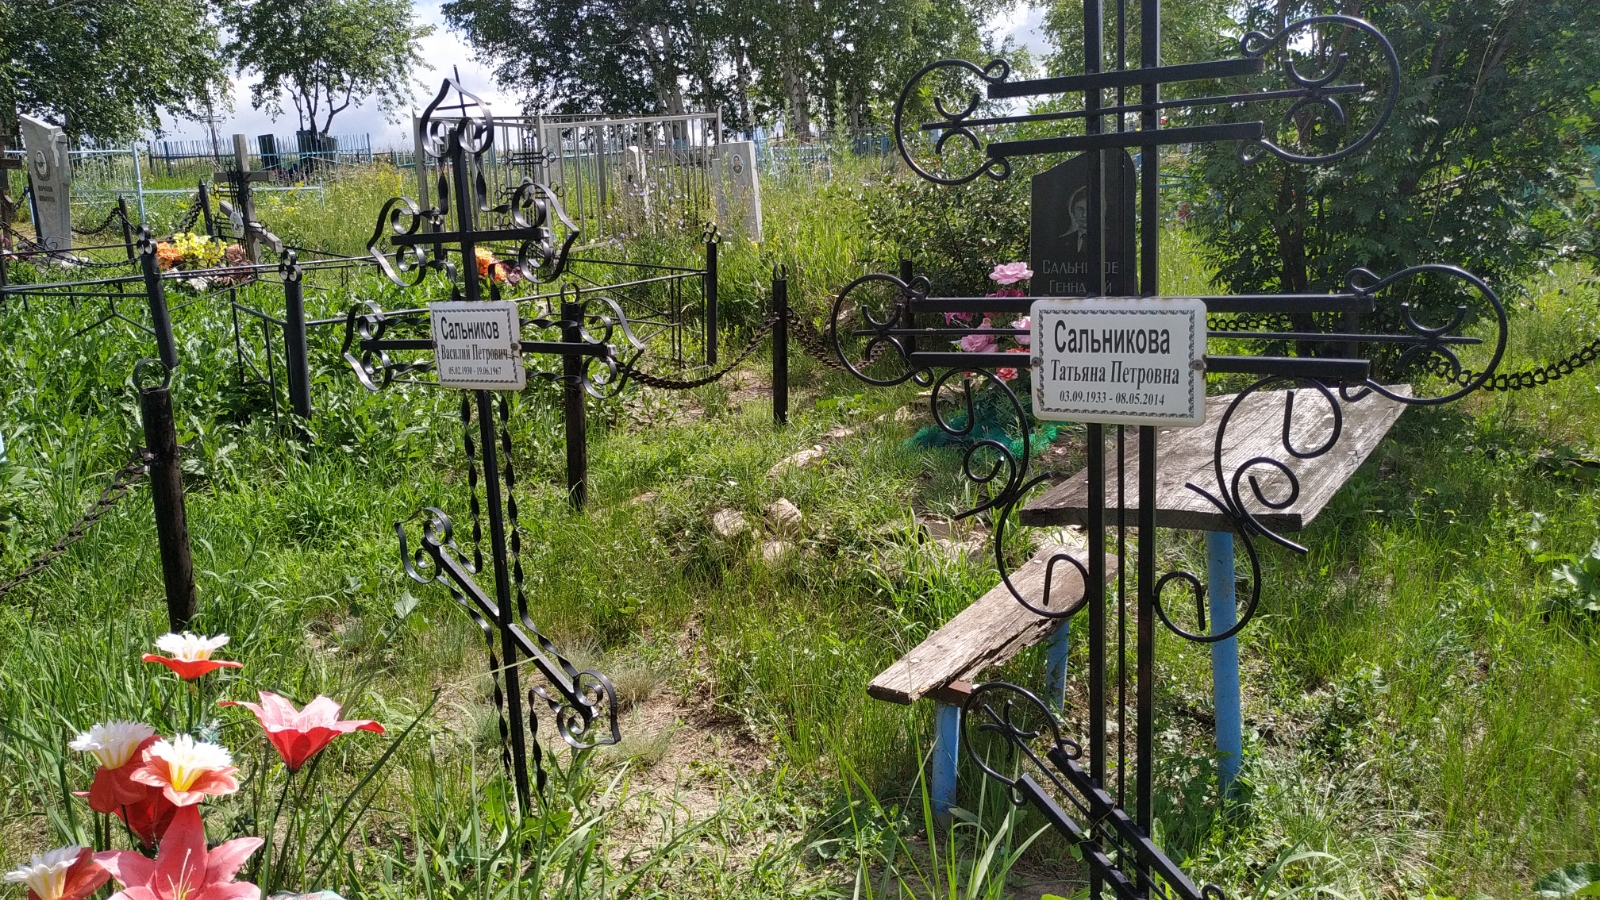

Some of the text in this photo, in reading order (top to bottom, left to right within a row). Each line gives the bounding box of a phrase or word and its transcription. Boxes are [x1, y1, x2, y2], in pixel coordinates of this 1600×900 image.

[1049, 280, 1112, 293] ГЕННАЙ
[440, 316, 500, 340] Сальников
[1054, 319, 1171, 354] Сальникова
[440, 344, 508, 364] Василий Петрович
[1051, 359, 1180, 390] Татьяна Петровна
[1059, 390, 1107, 403] 03.09.1933
[1115, 392, 1165, 406] 08.05.2014
